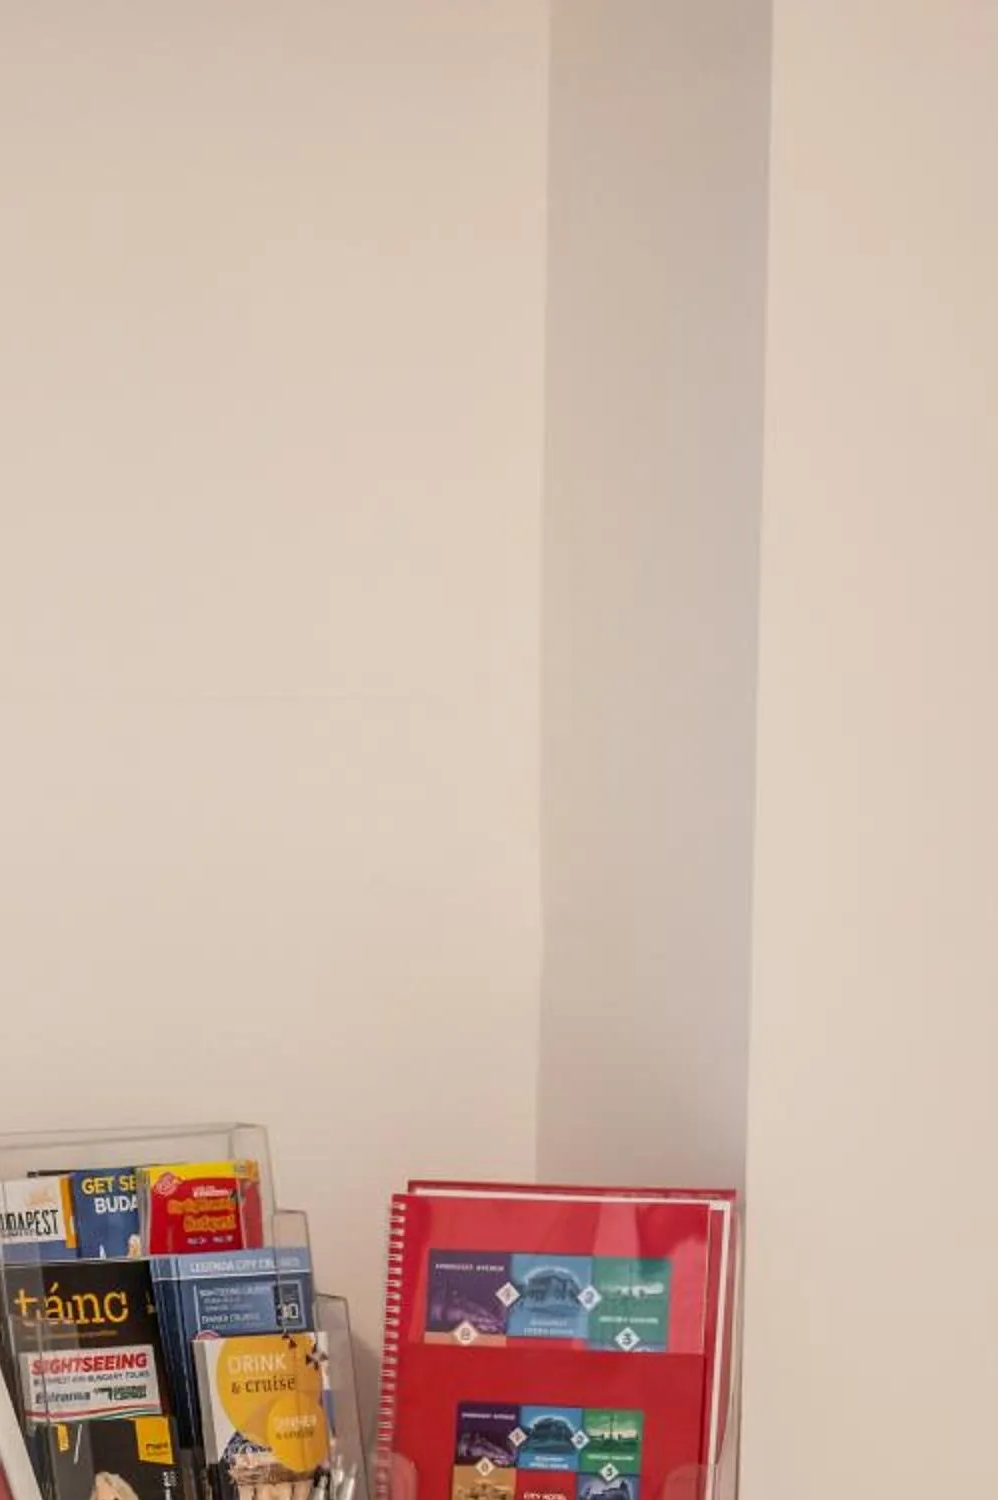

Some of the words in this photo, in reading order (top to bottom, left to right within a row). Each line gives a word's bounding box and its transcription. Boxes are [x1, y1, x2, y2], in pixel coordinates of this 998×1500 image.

[81, 1177, 114, 1194] GET
[32, 1353, 147, 1375] SIGHTSEEING
[227, 1353, 287, 1375] DRINK
[245, 1375, 297, 1393] cruise
[523, 1492, 542, 1500] CITY
